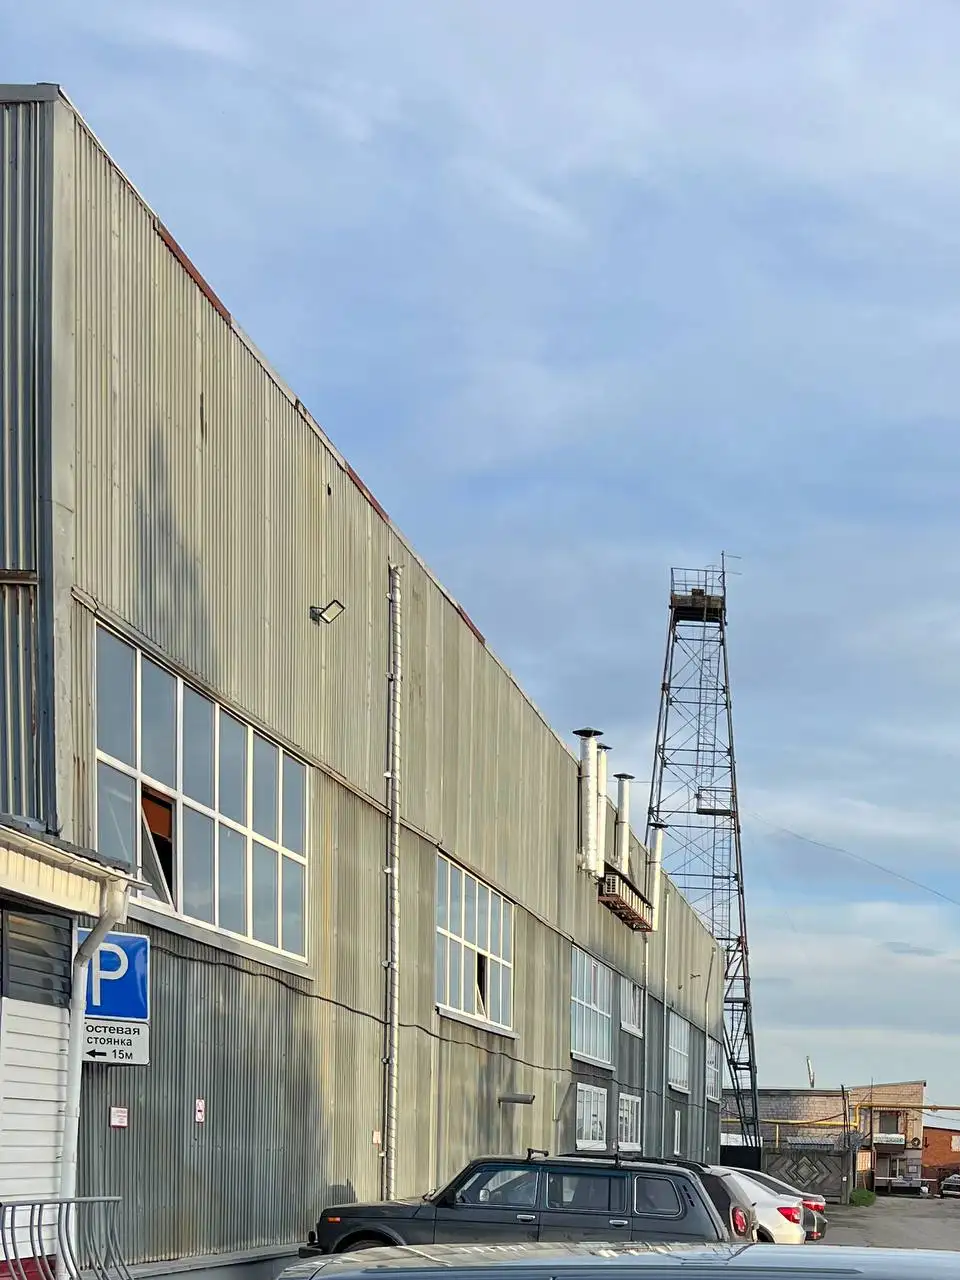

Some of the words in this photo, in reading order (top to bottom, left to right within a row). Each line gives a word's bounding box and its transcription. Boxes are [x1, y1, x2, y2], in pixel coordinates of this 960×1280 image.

[92, 943, 129, 1006] P
[84, 1022, 140, 1035] остевая
[86, 1036, 132, 1047] стоянка
[112, 1049, 133, 1060] 15м
